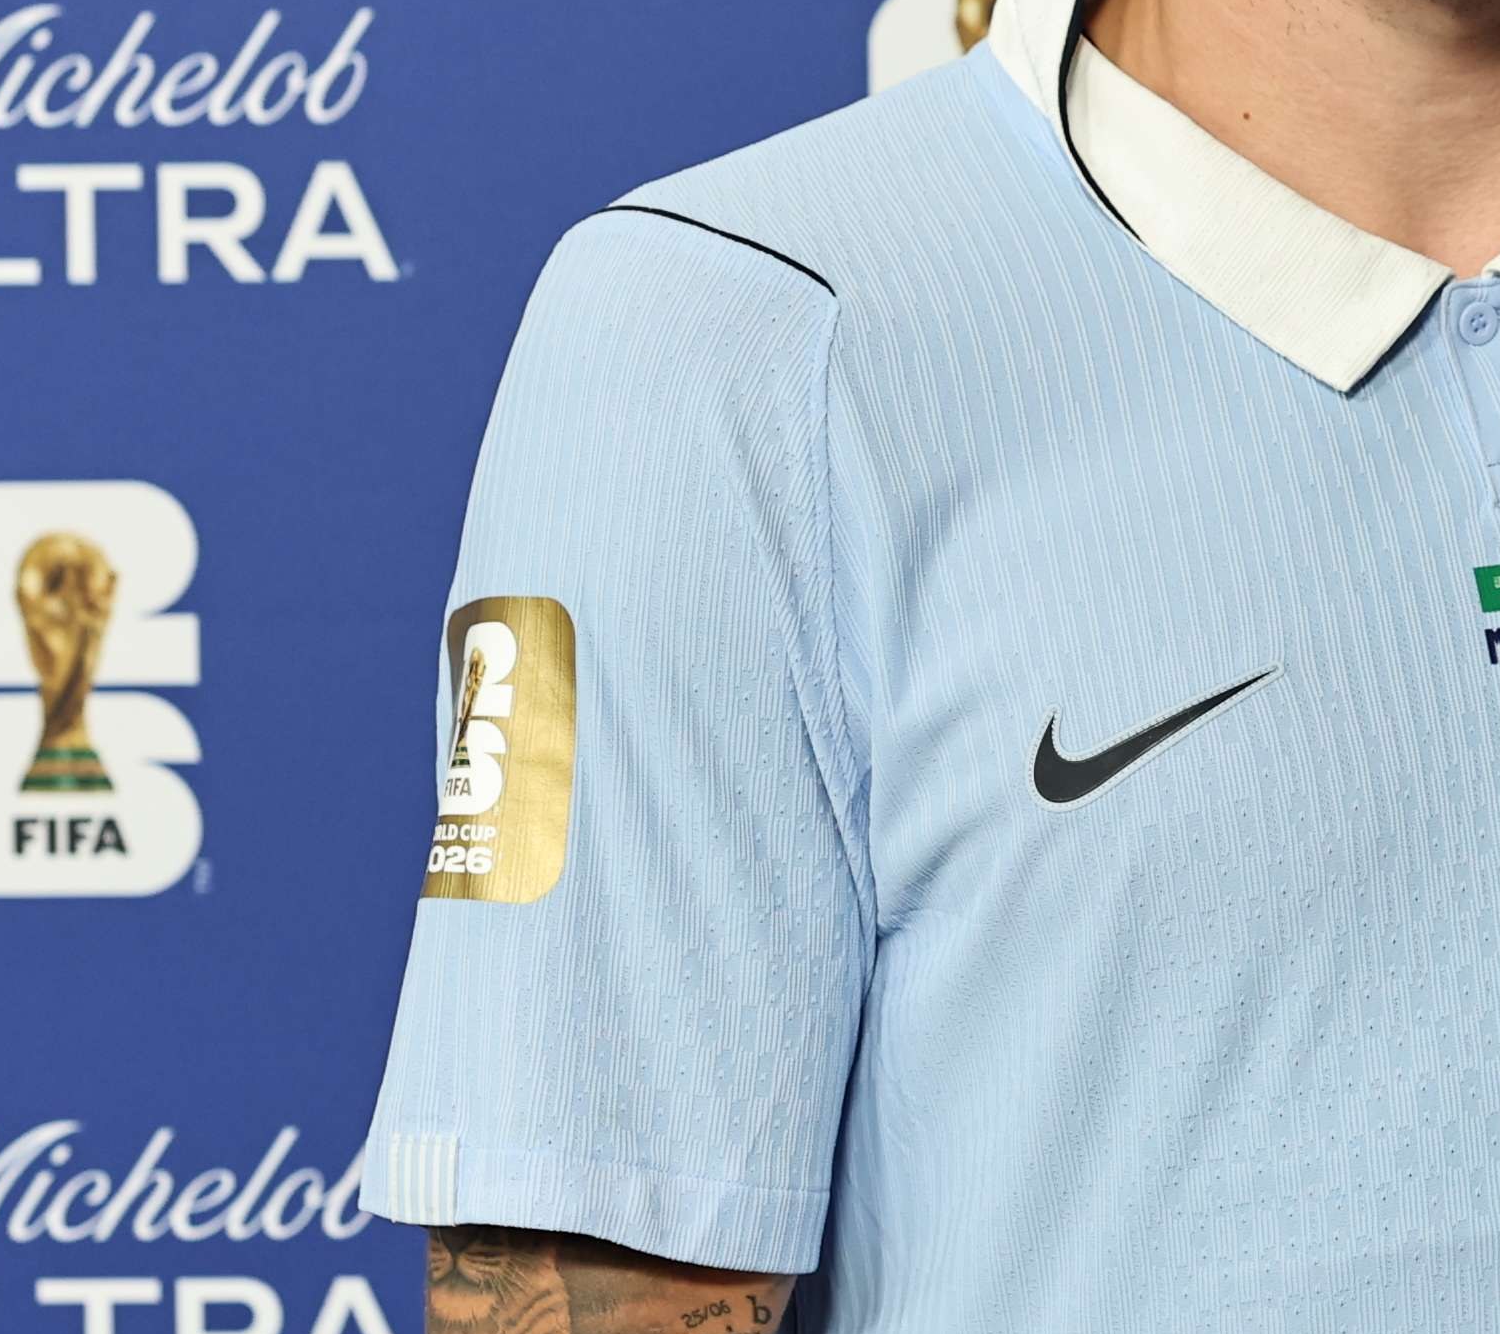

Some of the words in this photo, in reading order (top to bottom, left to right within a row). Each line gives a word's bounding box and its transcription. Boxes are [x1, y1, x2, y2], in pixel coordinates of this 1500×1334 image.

[12, 816, 129, 857] FIFA
[459, 822, 497, 843] CUP
[427, 844, 494, 875] 026
